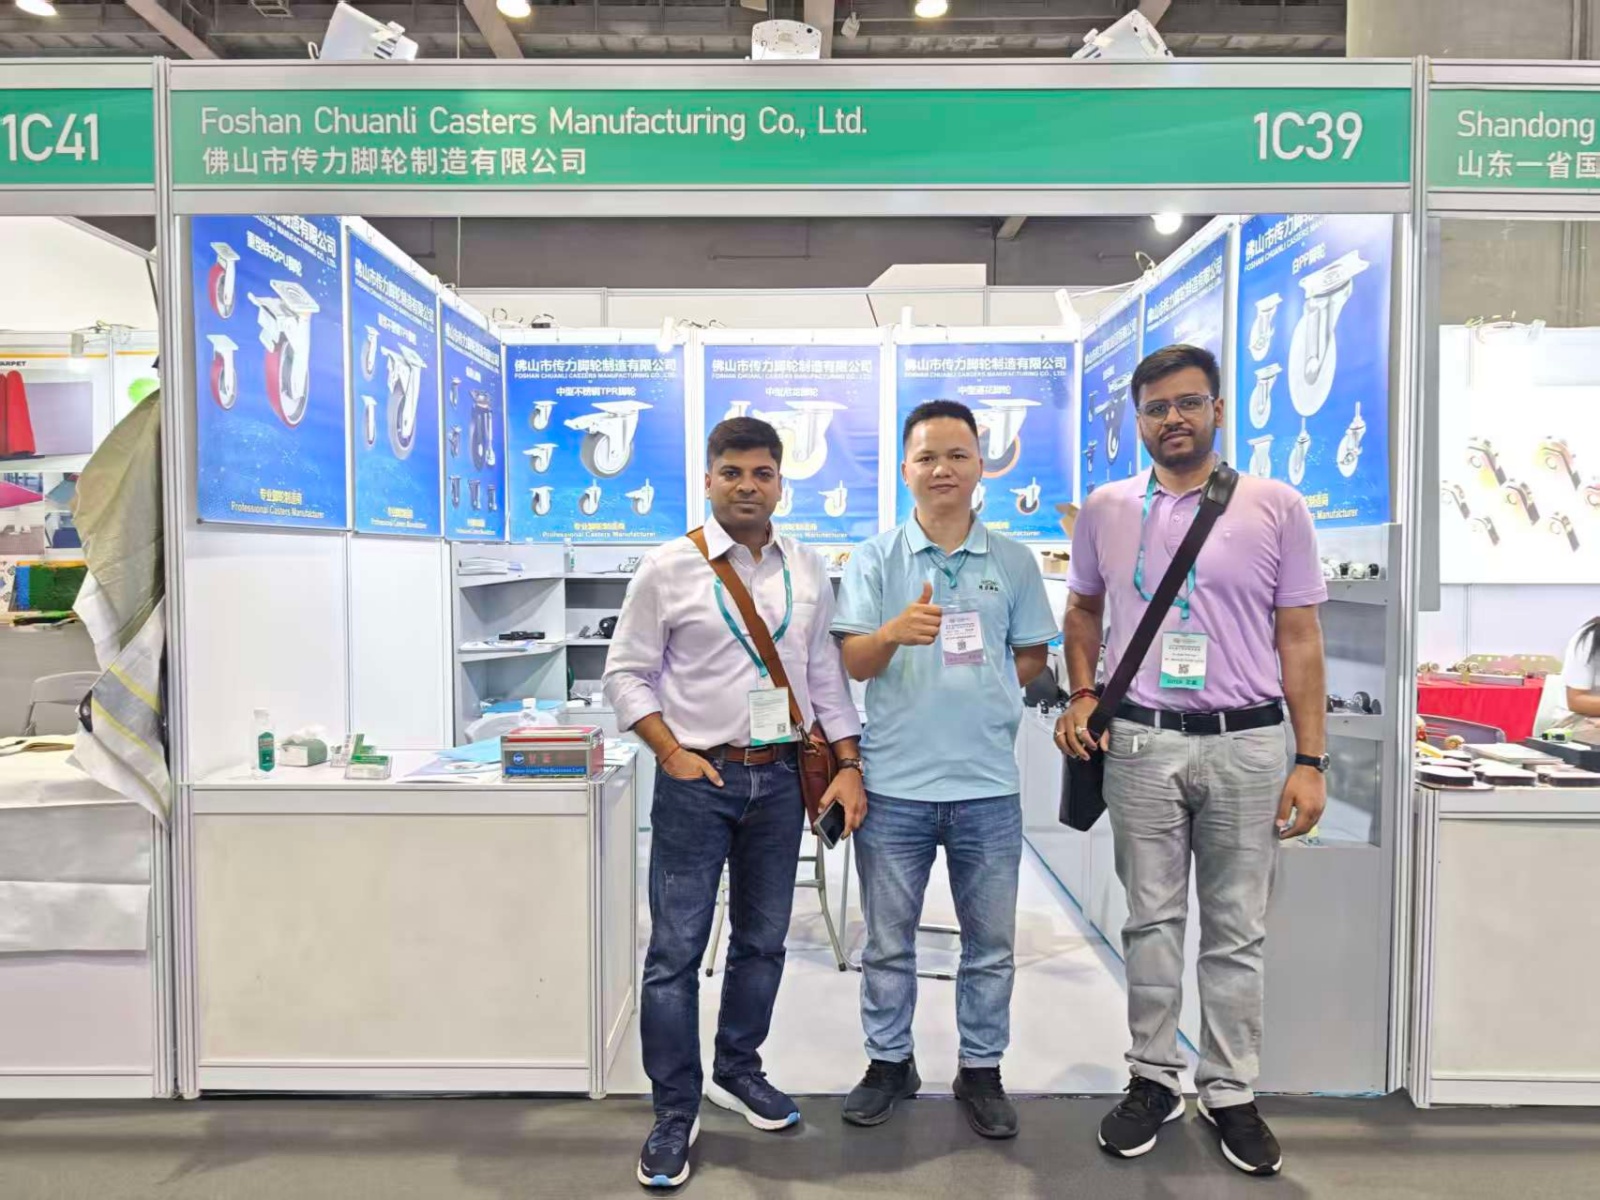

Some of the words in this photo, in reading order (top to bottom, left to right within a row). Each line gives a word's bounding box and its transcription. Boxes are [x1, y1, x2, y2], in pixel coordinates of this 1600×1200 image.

[2, 113, 99, 161] 1C41
[201, 107, 302, 135] Foshan
[314, 106, 417, 135] Chuanli
[430, 107, 537, 135] Casters
[549, 106, 746, 141] Manufacturing
[759, 107, 814, 137] Co.,
[819, 106, 867, 135] Ltd.
[1253, 111, 1363, 161] 1C39
[1457, 109, 1595, 145] Shandong
[202, 146, 588, 176] 佛山市传力脚轮制造有限公司
[1457, 150, 1600, 179] 山东一省国
[514, 358, 677, 372] 佛山市传力脚轮制造有限公司
[711, 358, 873, 372] 佛山市传力脚轮制造有限公司
[904, 357, 1067, 371] 佛山市传力脚轮制造有限公司
